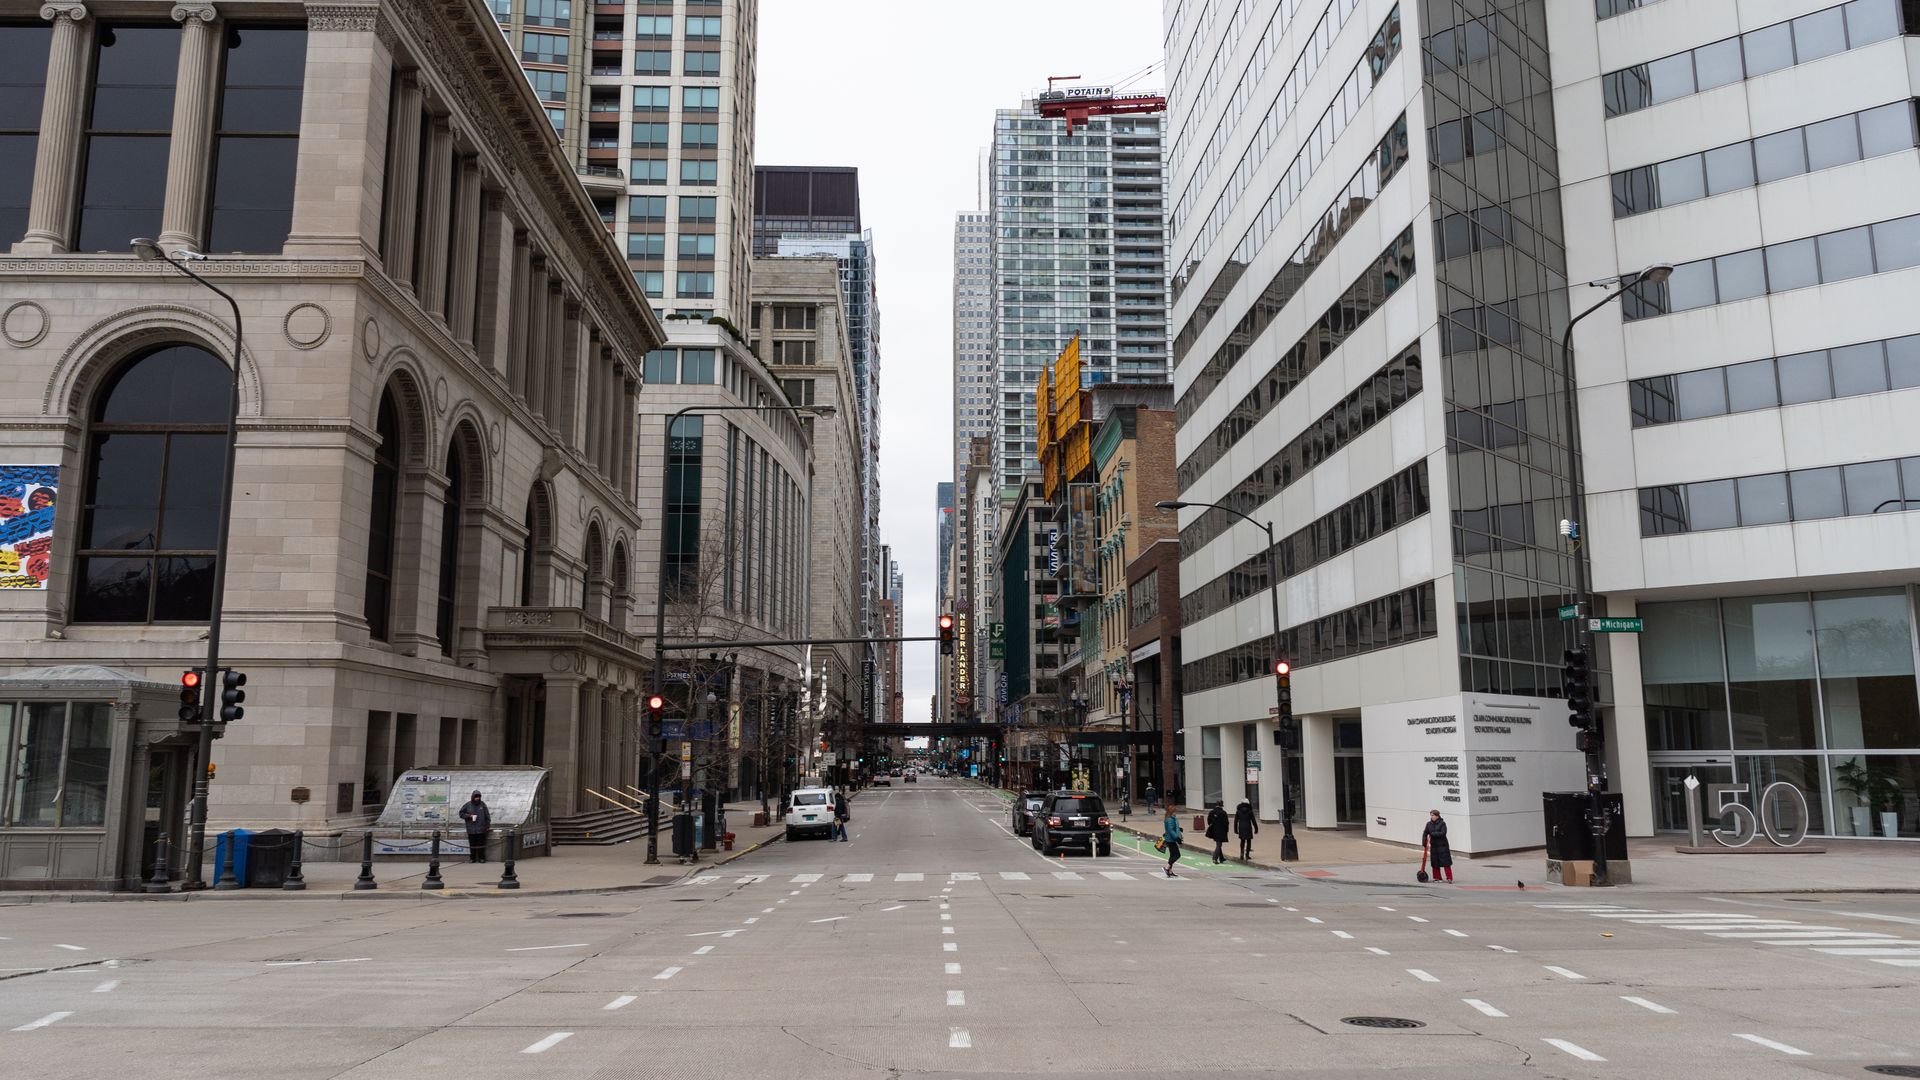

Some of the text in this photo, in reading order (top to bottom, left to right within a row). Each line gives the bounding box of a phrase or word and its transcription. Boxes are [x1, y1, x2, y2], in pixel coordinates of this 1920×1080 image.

[1067, 87, 1103, 96] POTAIN
[1605, 620, 1635, 631] Michigan
[1000, 676, 1008, 702] ROSS
[1683, 774, 1809, 848] 150
